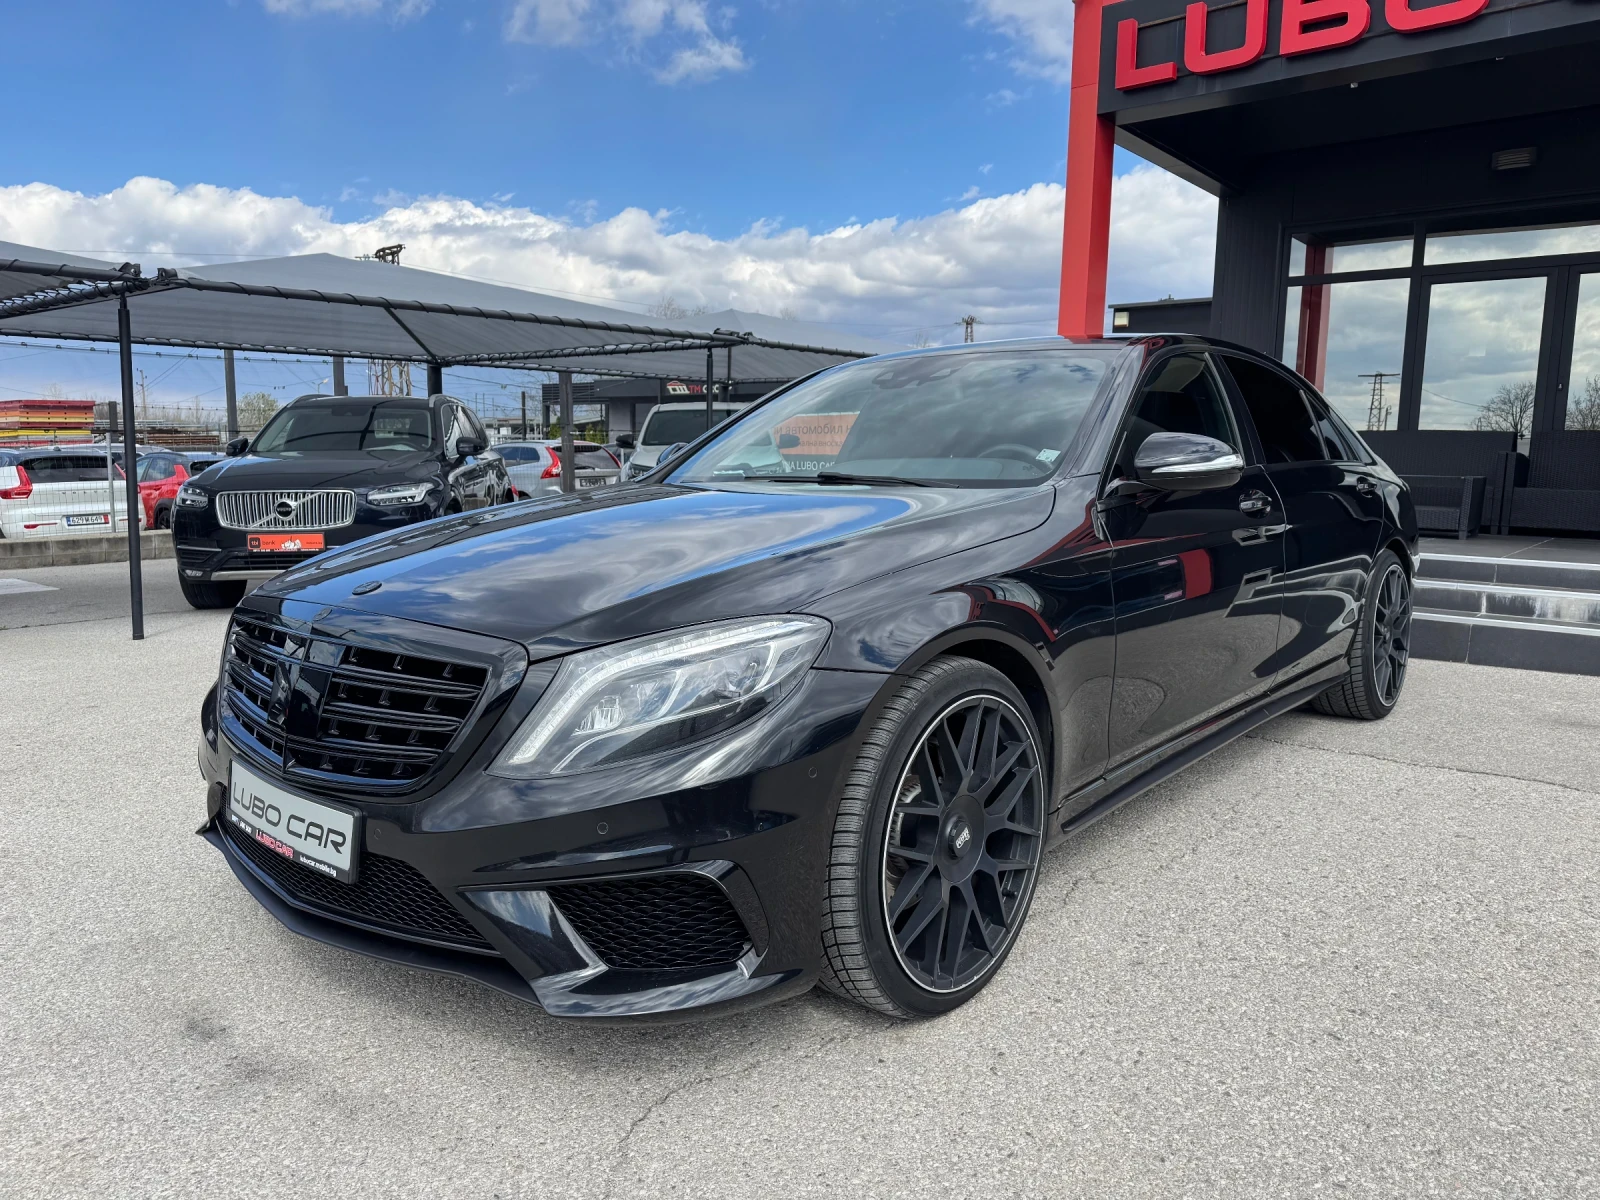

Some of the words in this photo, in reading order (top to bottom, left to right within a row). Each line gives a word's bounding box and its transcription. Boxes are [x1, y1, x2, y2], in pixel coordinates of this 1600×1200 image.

[785, 423, 843, 435] автомобил
[796, 461, 818, 471] LUBO
[232, 781, 282, 828] LUBO
[286, 813, 347, 855] CAR
[255, 829, 276, 849] LUBO
[275, 839, 294, 859] CAR
